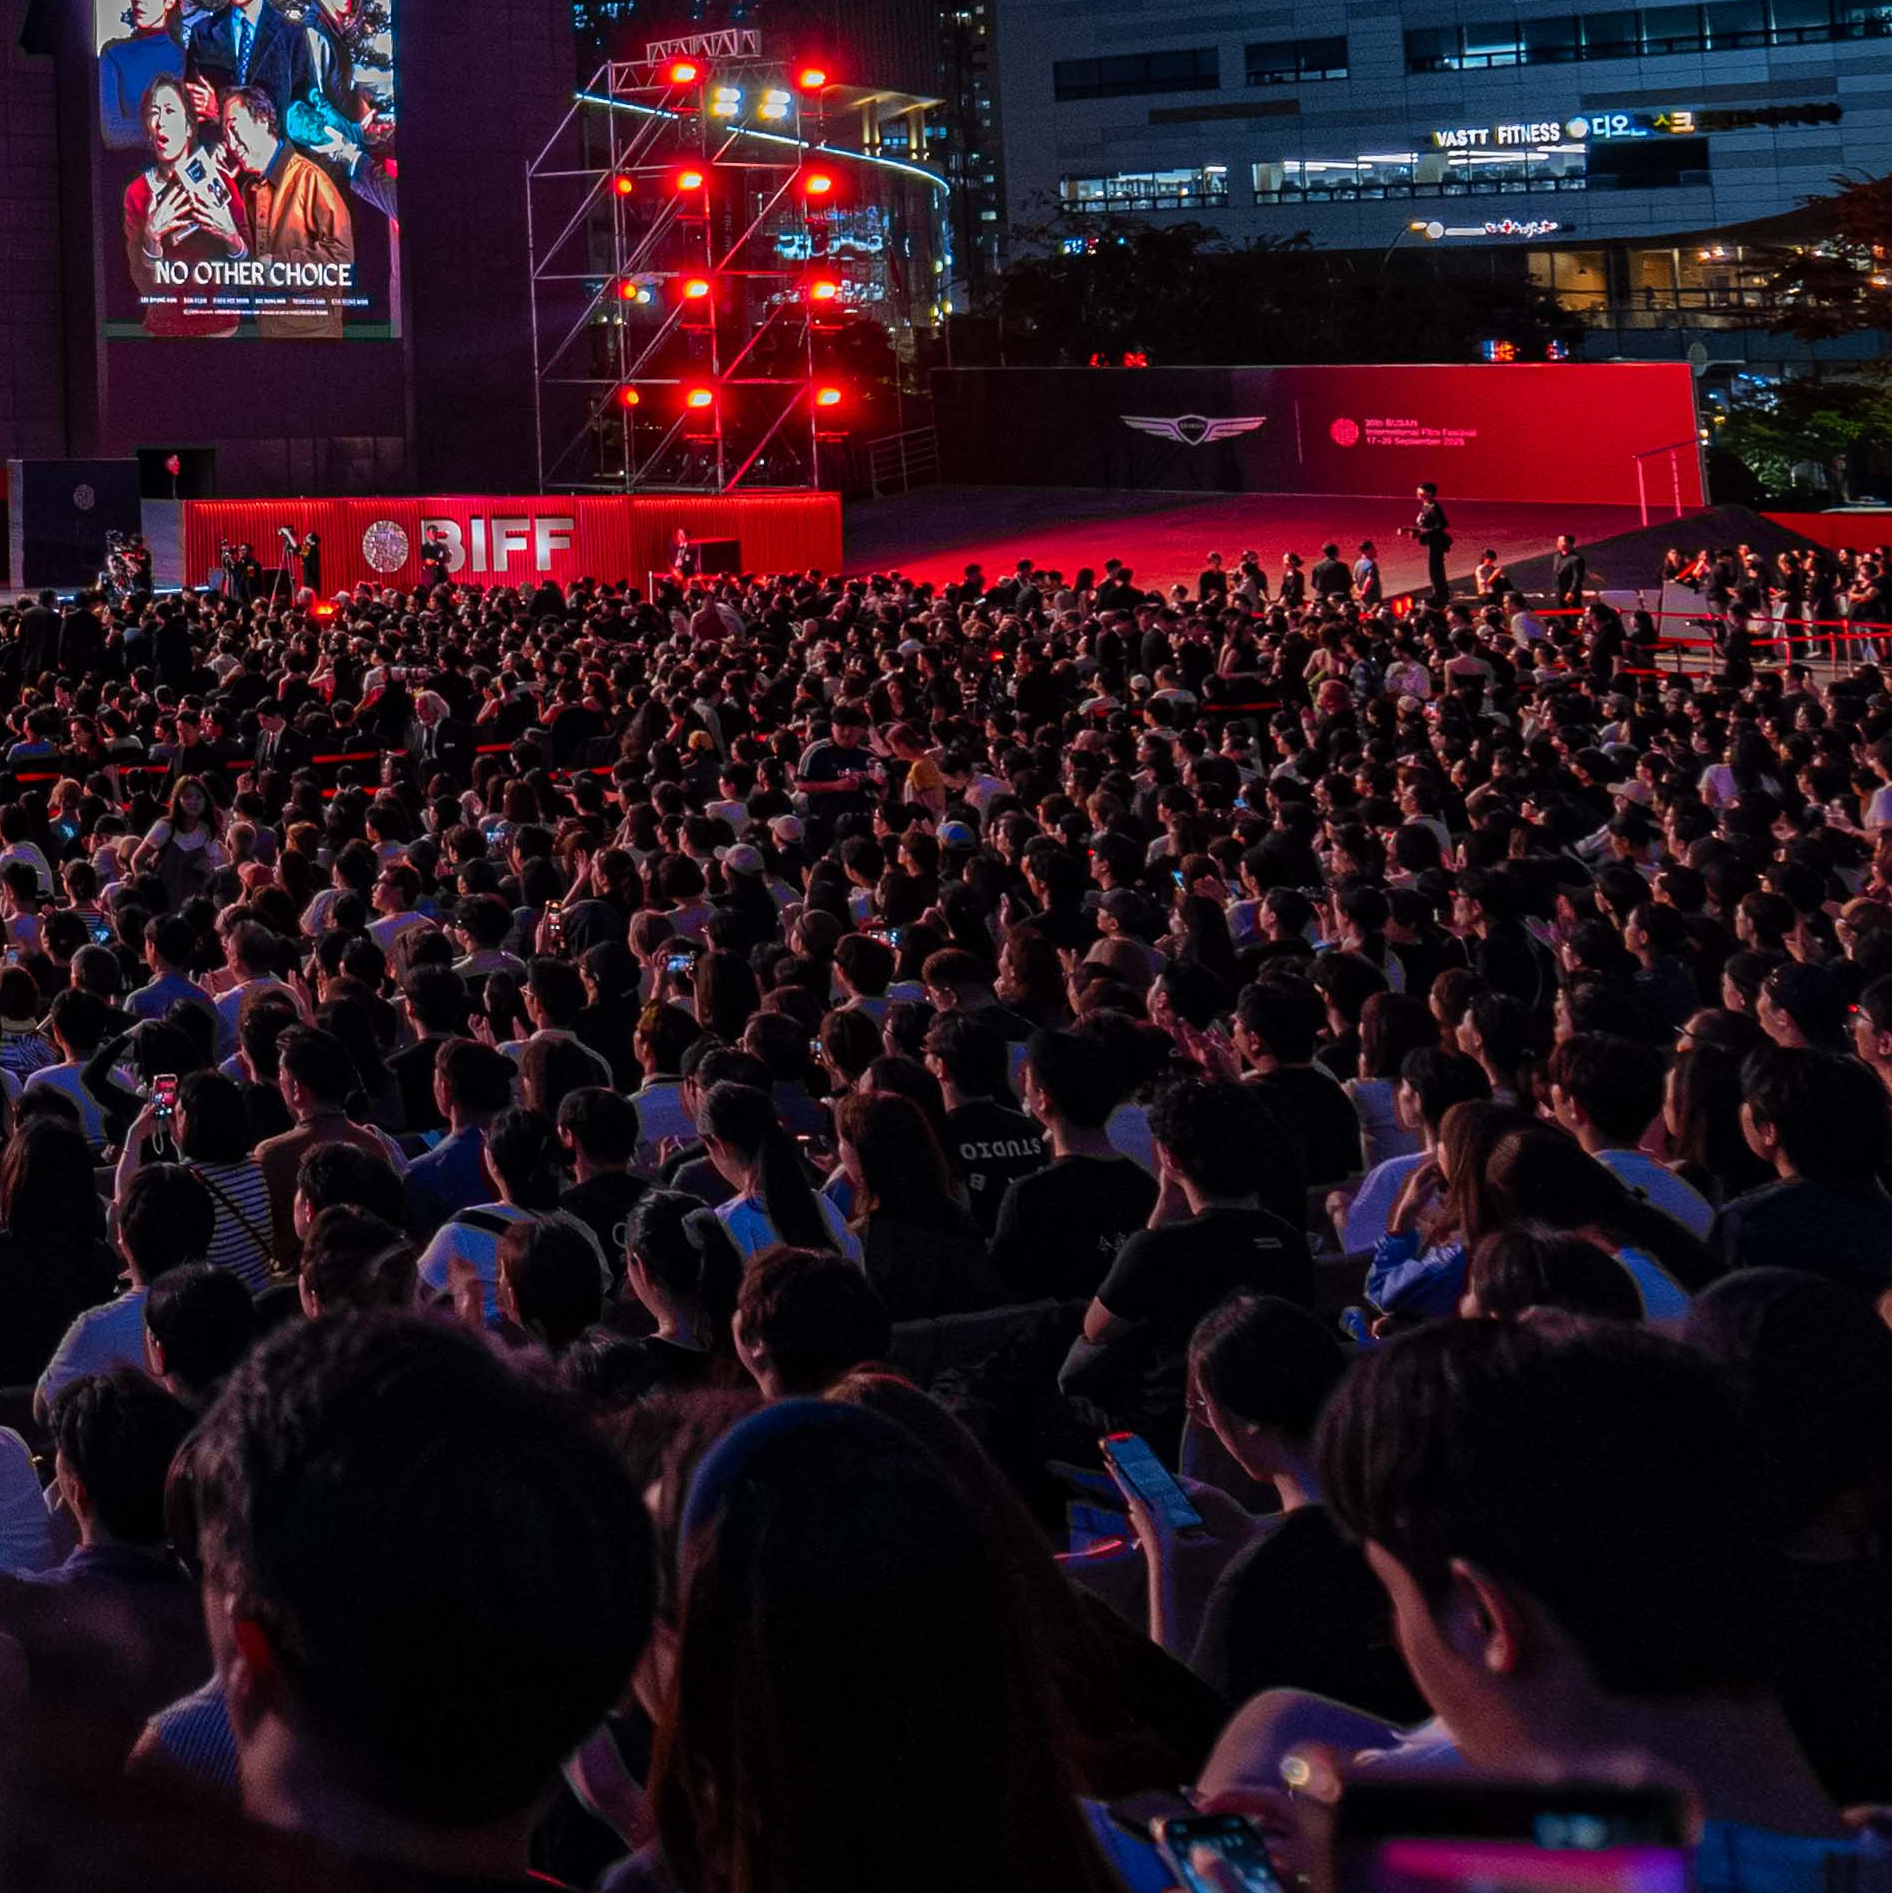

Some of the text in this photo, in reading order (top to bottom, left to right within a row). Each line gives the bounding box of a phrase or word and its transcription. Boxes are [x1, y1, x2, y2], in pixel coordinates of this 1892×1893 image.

[1436, 121, 1561, 148] VASTT FITNESS
[155, 261, 352, 287] NO OTHER CHOICE
